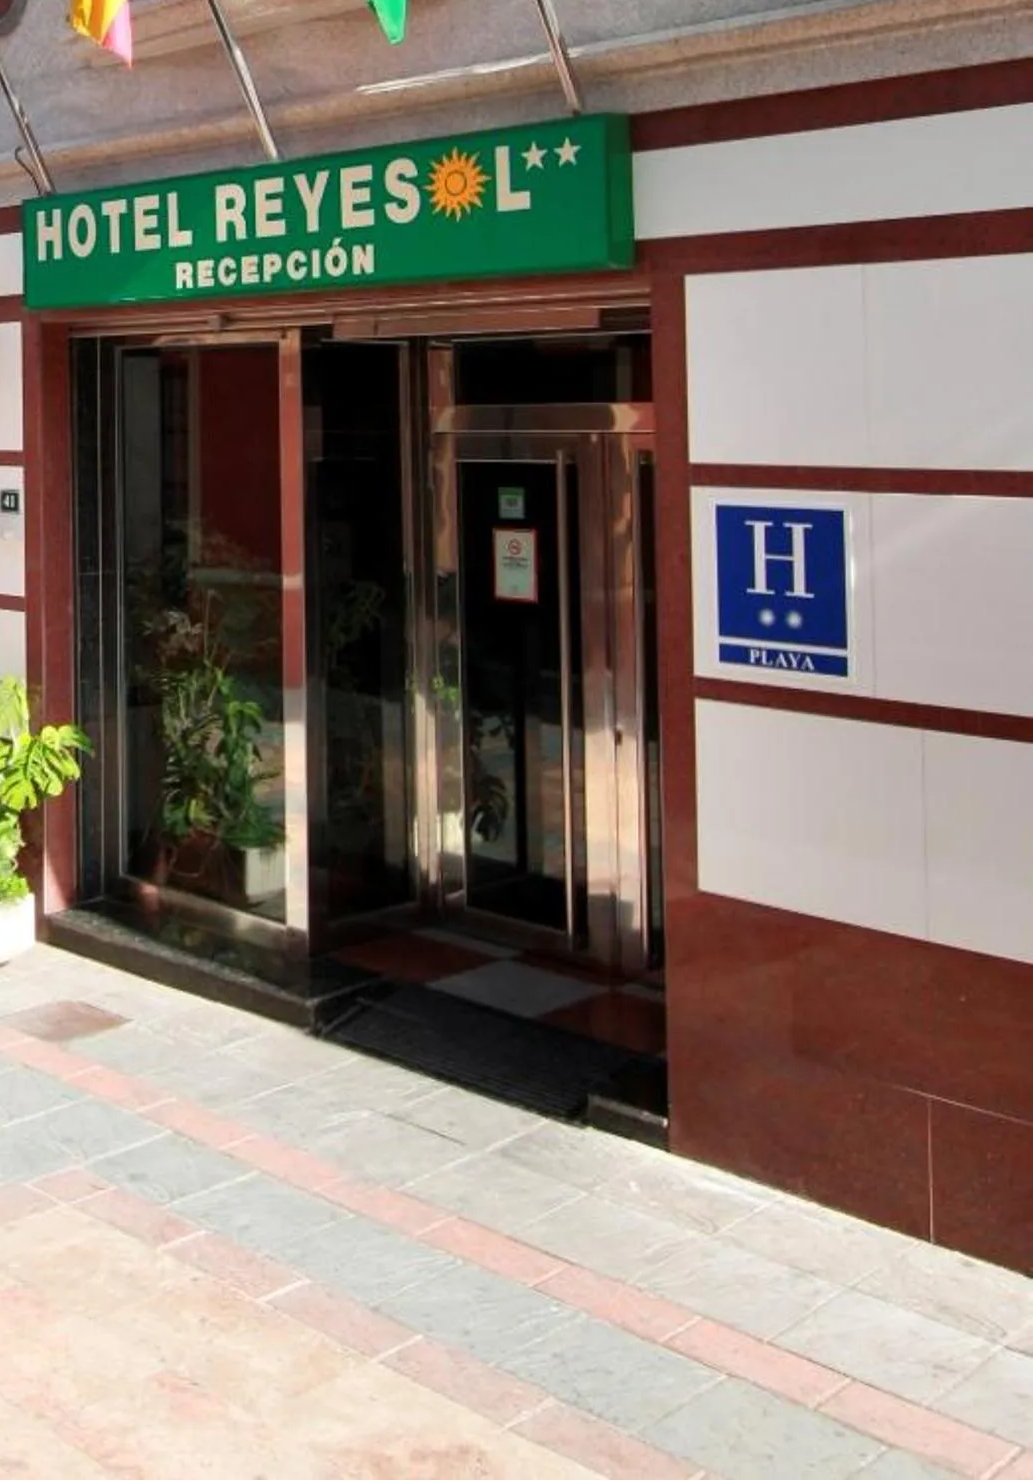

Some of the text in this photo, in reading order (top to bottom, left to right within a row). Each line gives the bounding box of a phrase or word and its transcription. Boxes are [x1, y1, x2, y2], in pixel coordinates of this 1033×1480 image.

[36, 192, 193, 261] HOTEL
[174, 238, 375, 289] RECEPCIÓN
[744, 520, 815, 599] H
[748, 648, 815, 671] PLAYA
